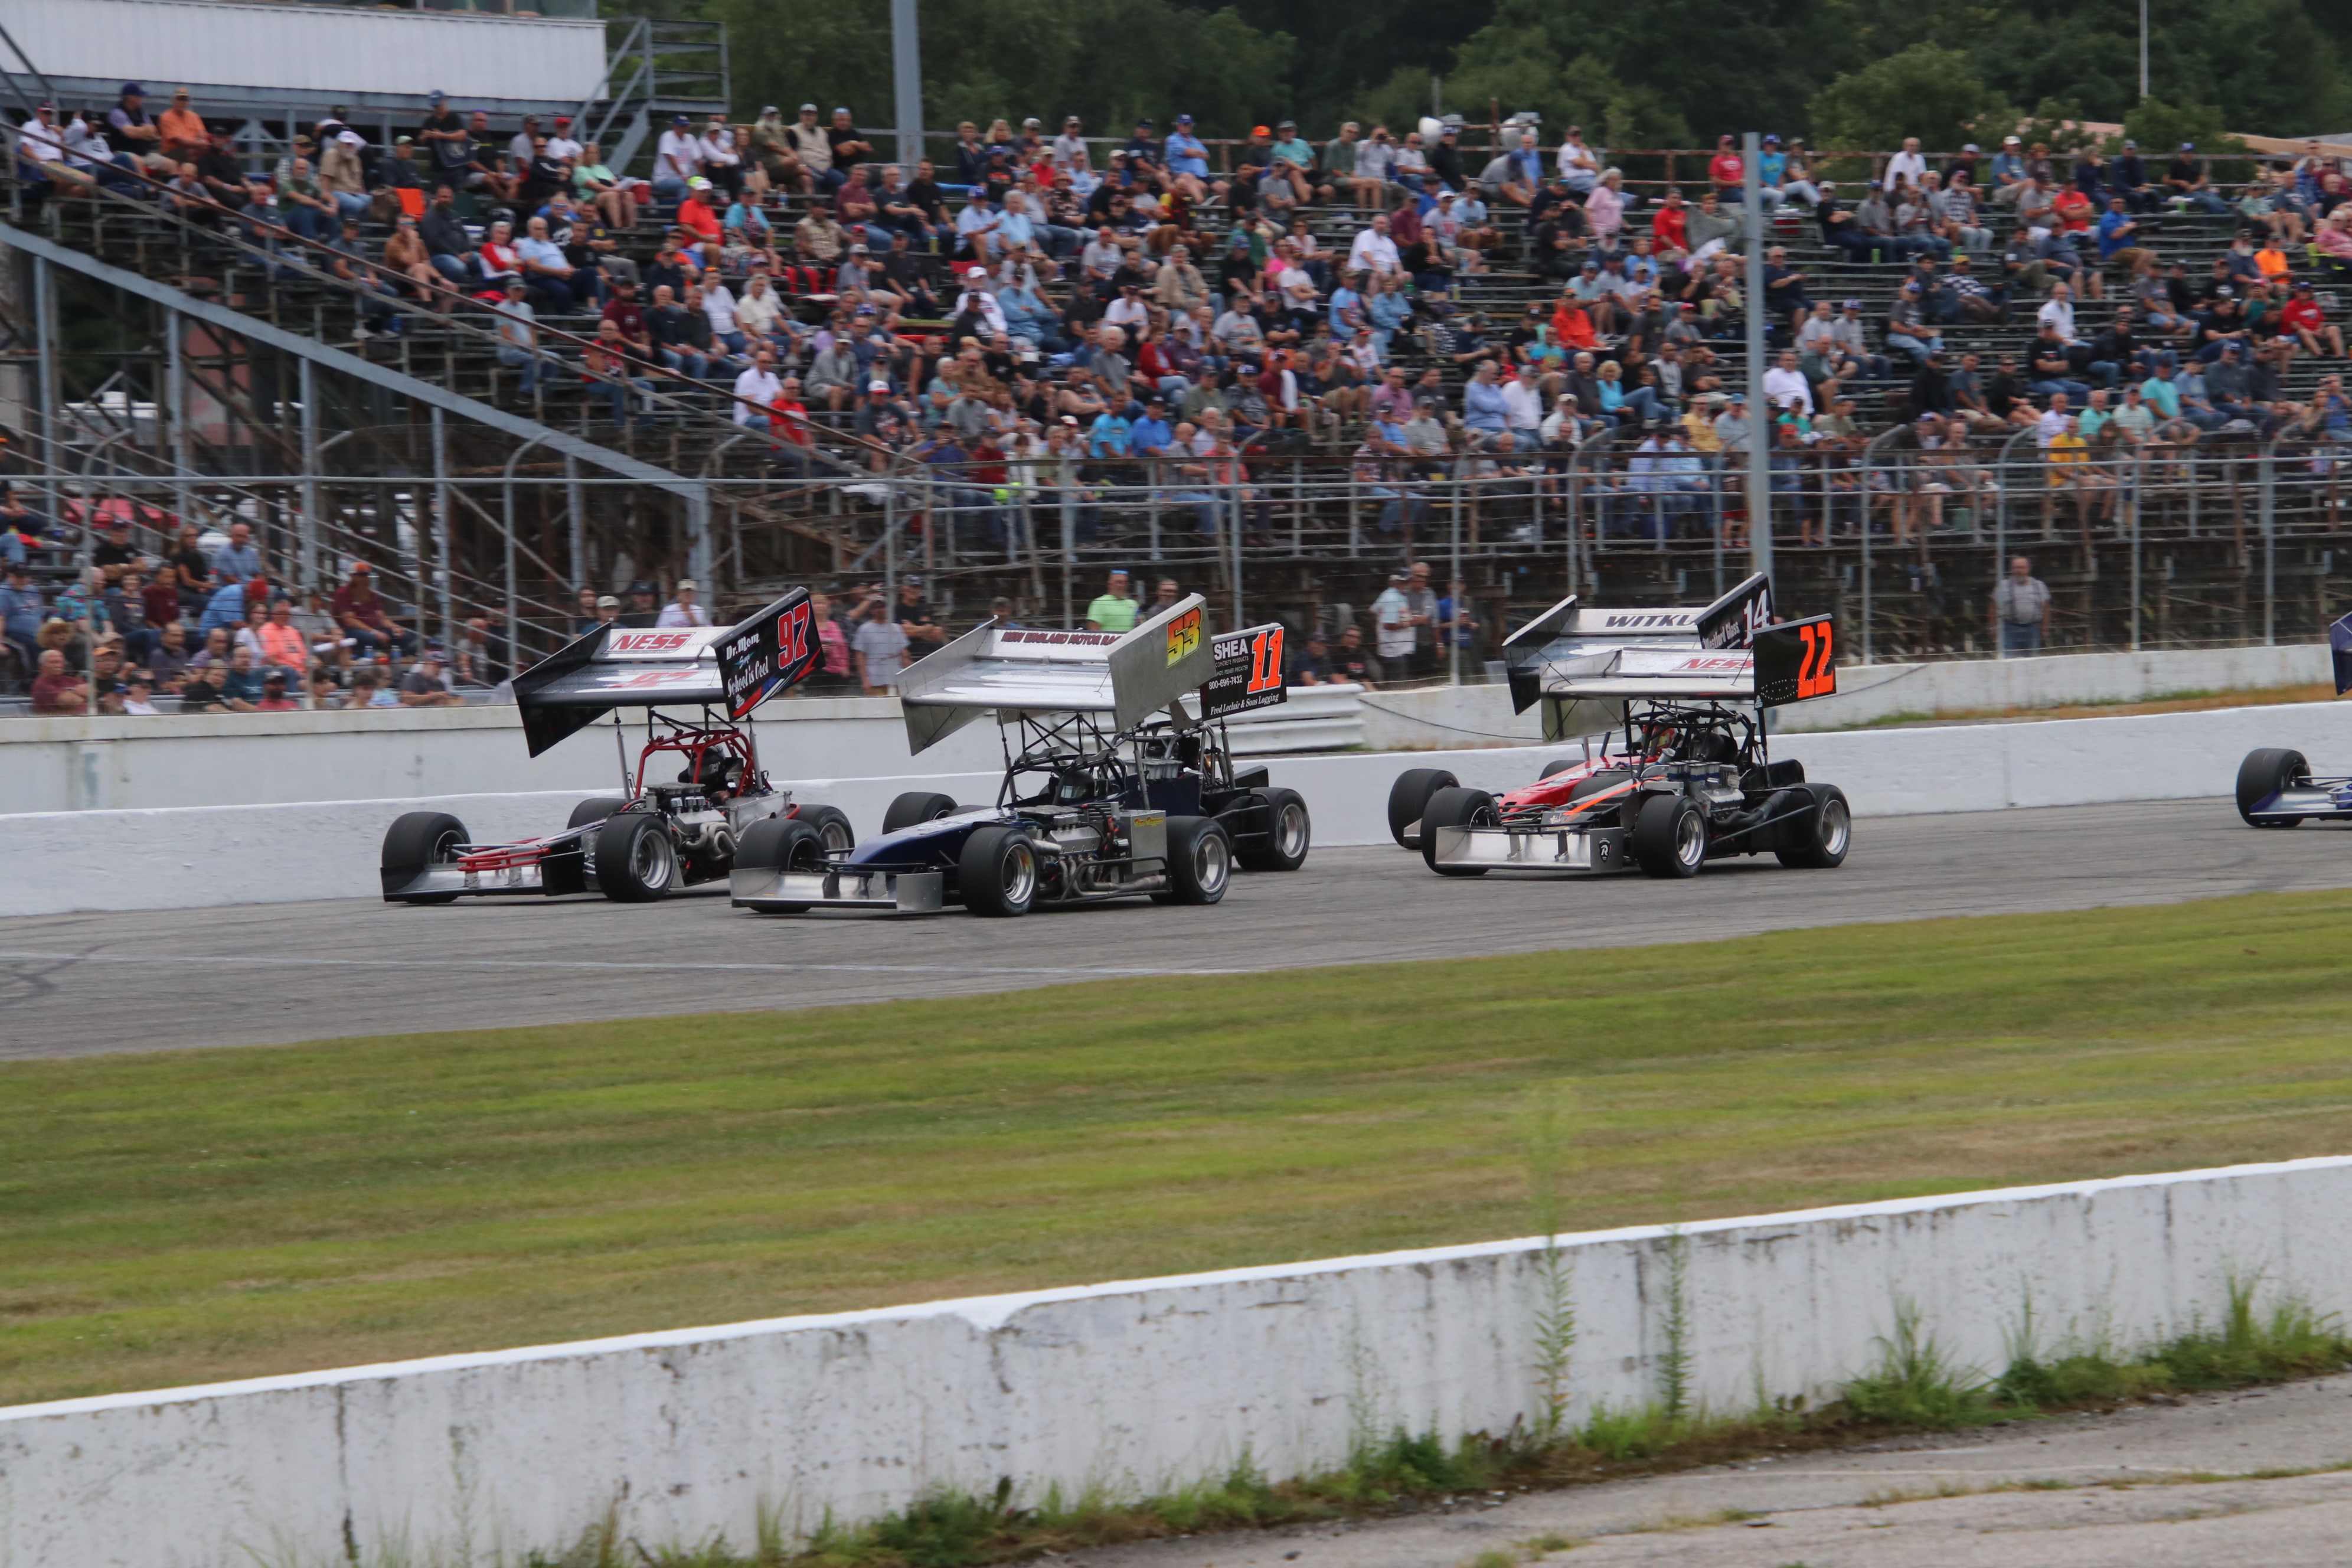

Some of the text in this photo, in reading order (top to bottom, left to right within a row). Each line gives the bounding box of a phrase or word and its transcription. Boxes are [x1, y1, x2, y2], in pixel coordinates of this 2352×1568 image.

[1743, 589, 1770, 646] 14
[610, 633, 692, 650] NESS
[778, 600, 810, 669] 97
[1001, 632, 1026, 642] NEW
[1023, 632, 1069, 644] ENGLAND
[1067, 635, 1102, 645] MOTOR
[1167, 605, 1202, 668] 53
[1726, 622, 1740, 639] Glass
[1214, 638, 1249, 660] SHEA
[1247, 626, 1284, 694] 11
[1798, 622, 1834, 698] 22
[1216, 656, 1249, 668] CONCRETE PRODUCTS
[1209, 675, 1243, 690] 800-696-7432
[1210, 704, 1223, 716] Fred
[1240, 699, 1245, 708] &
[1246, 698, 1257, 707] Sons
[1258, 693, 1279, 704] Logging
